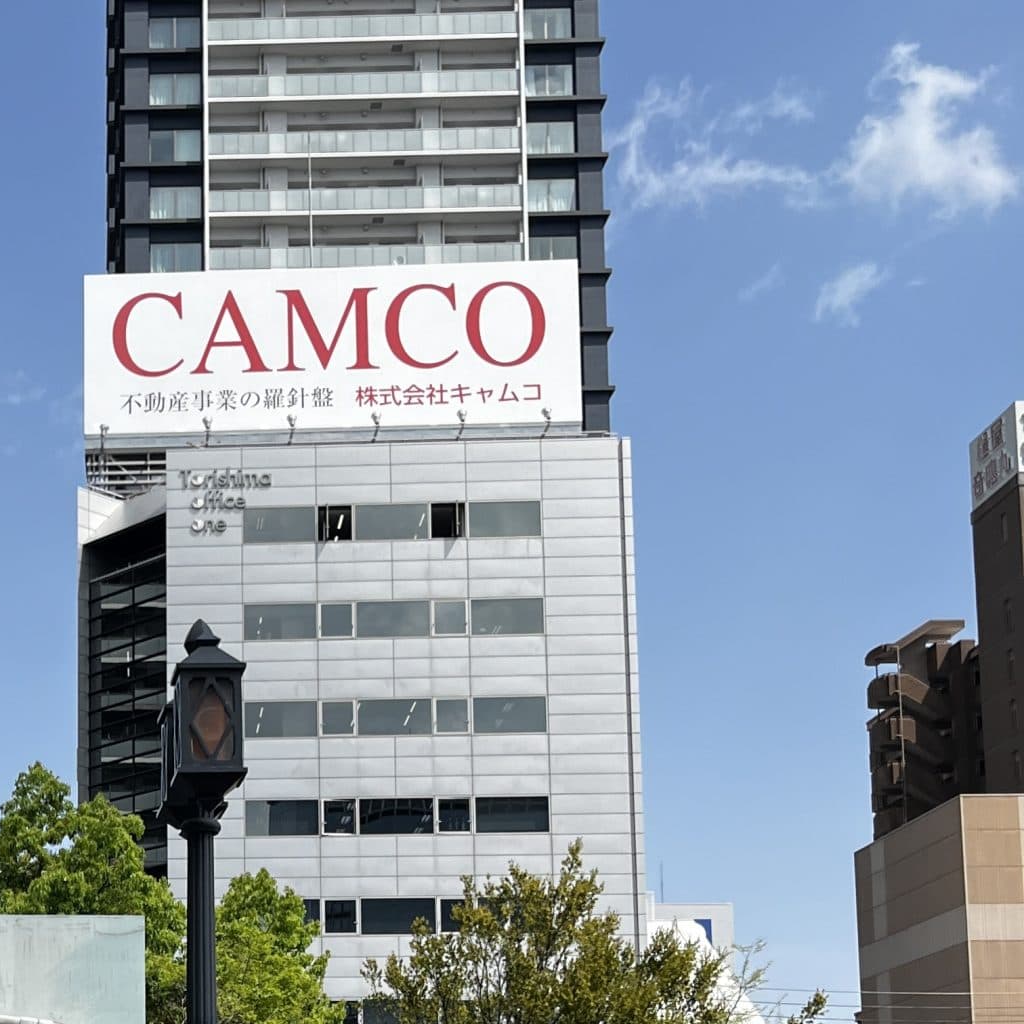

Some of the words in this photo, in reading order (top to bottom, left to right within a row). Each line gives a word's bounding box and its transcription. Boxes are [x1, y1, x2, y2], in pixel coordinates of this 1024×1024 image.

[112, 281, 546, 377] CAMCO
[120, 387, 335, 415] 不動産事業の羅針盤
[355, 383, 541, 407] 株式会社キャムコ
[179, 467, 271, 489] Torishima
